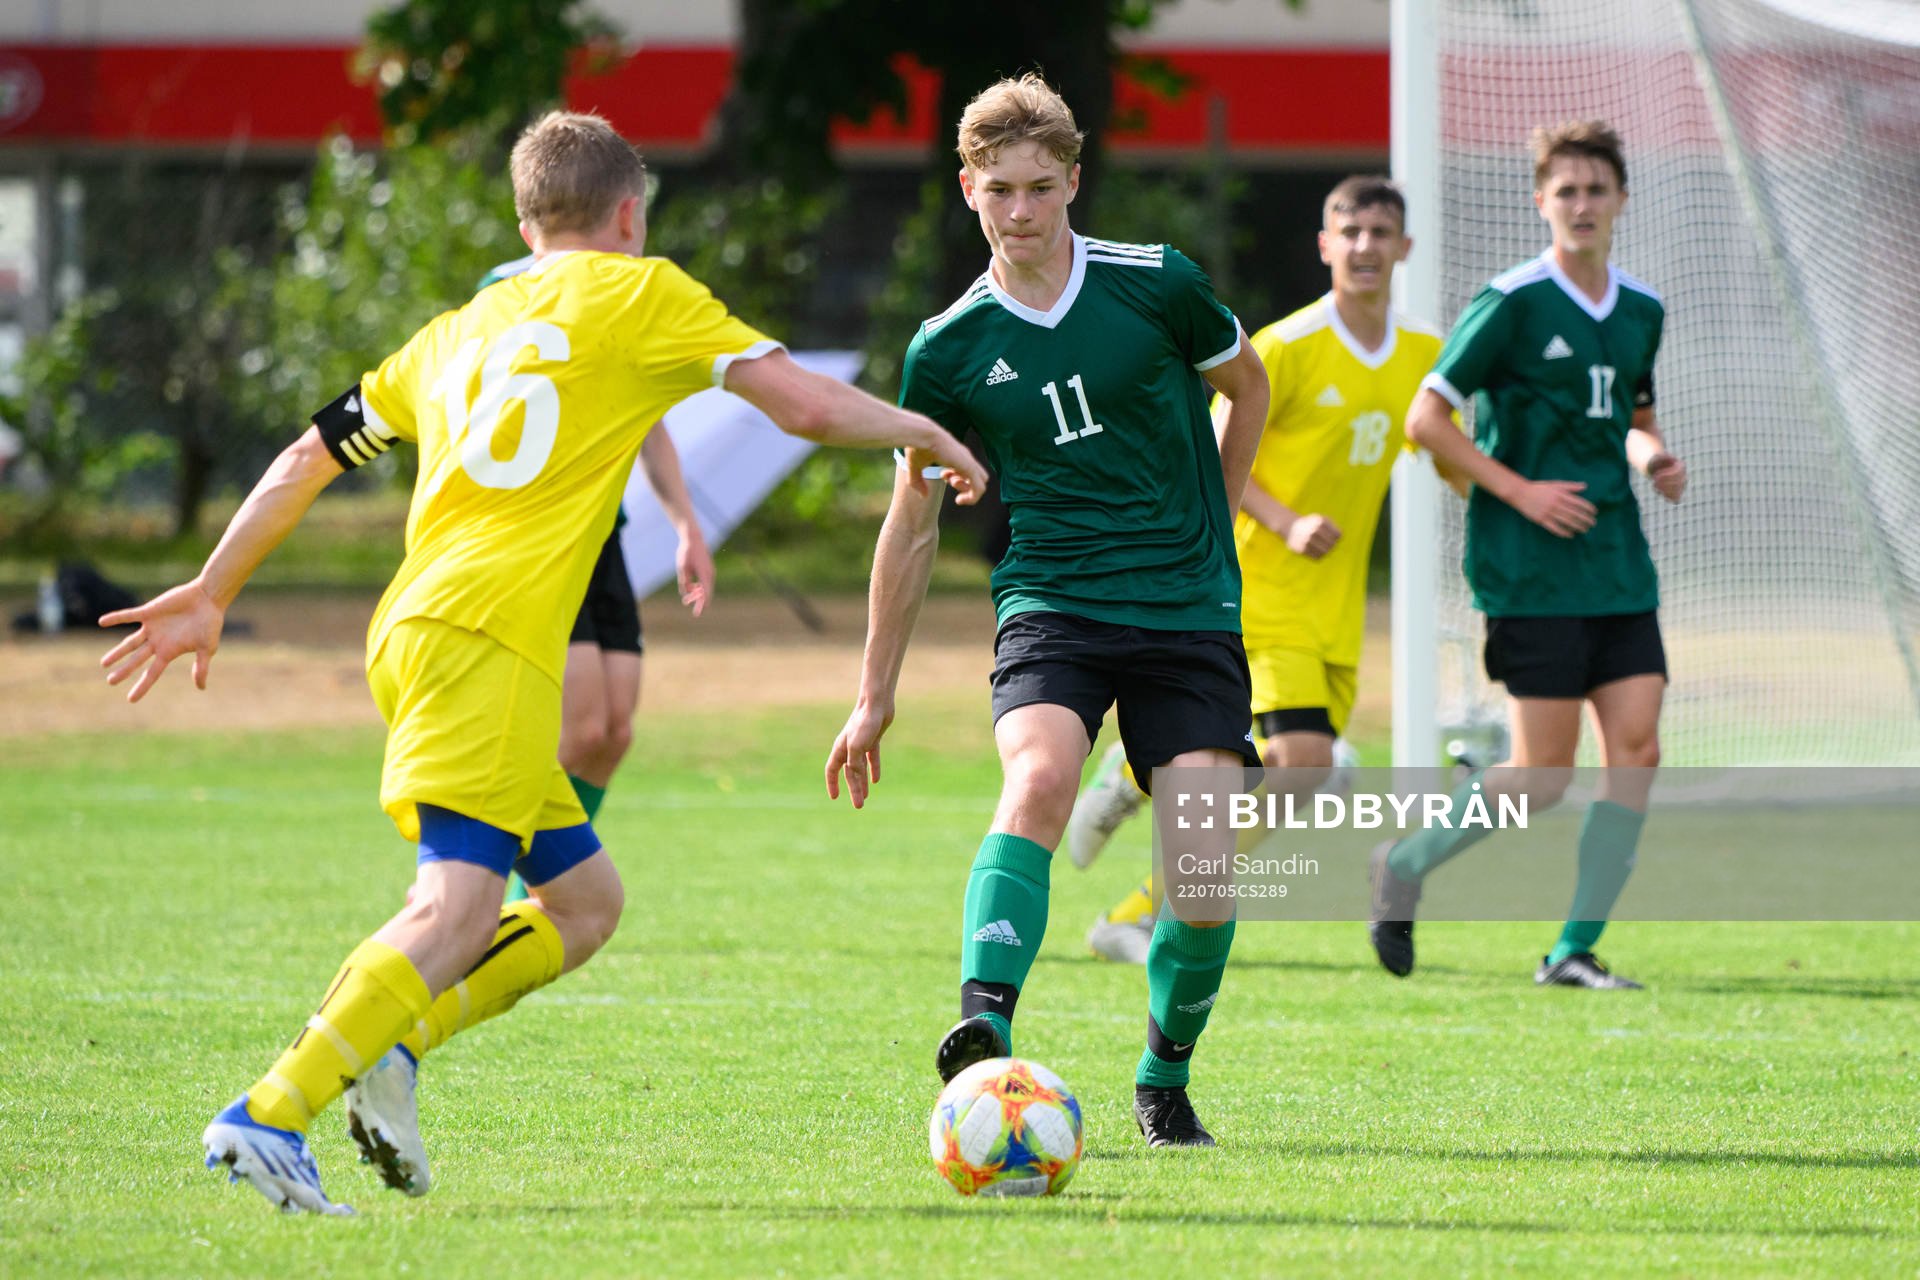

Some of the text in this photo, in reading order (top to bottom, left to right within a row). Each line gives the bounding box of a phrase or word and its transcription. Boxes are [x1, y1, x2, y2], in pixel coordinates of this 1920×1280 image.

[426, 321, 571, 492] 16
[986, 371, 1019, 386] adidas
[1041, 374, 1104, 446] 11
[1349, 410, 1392, 467] 18
[972, 931, 1022, 947] adidas
